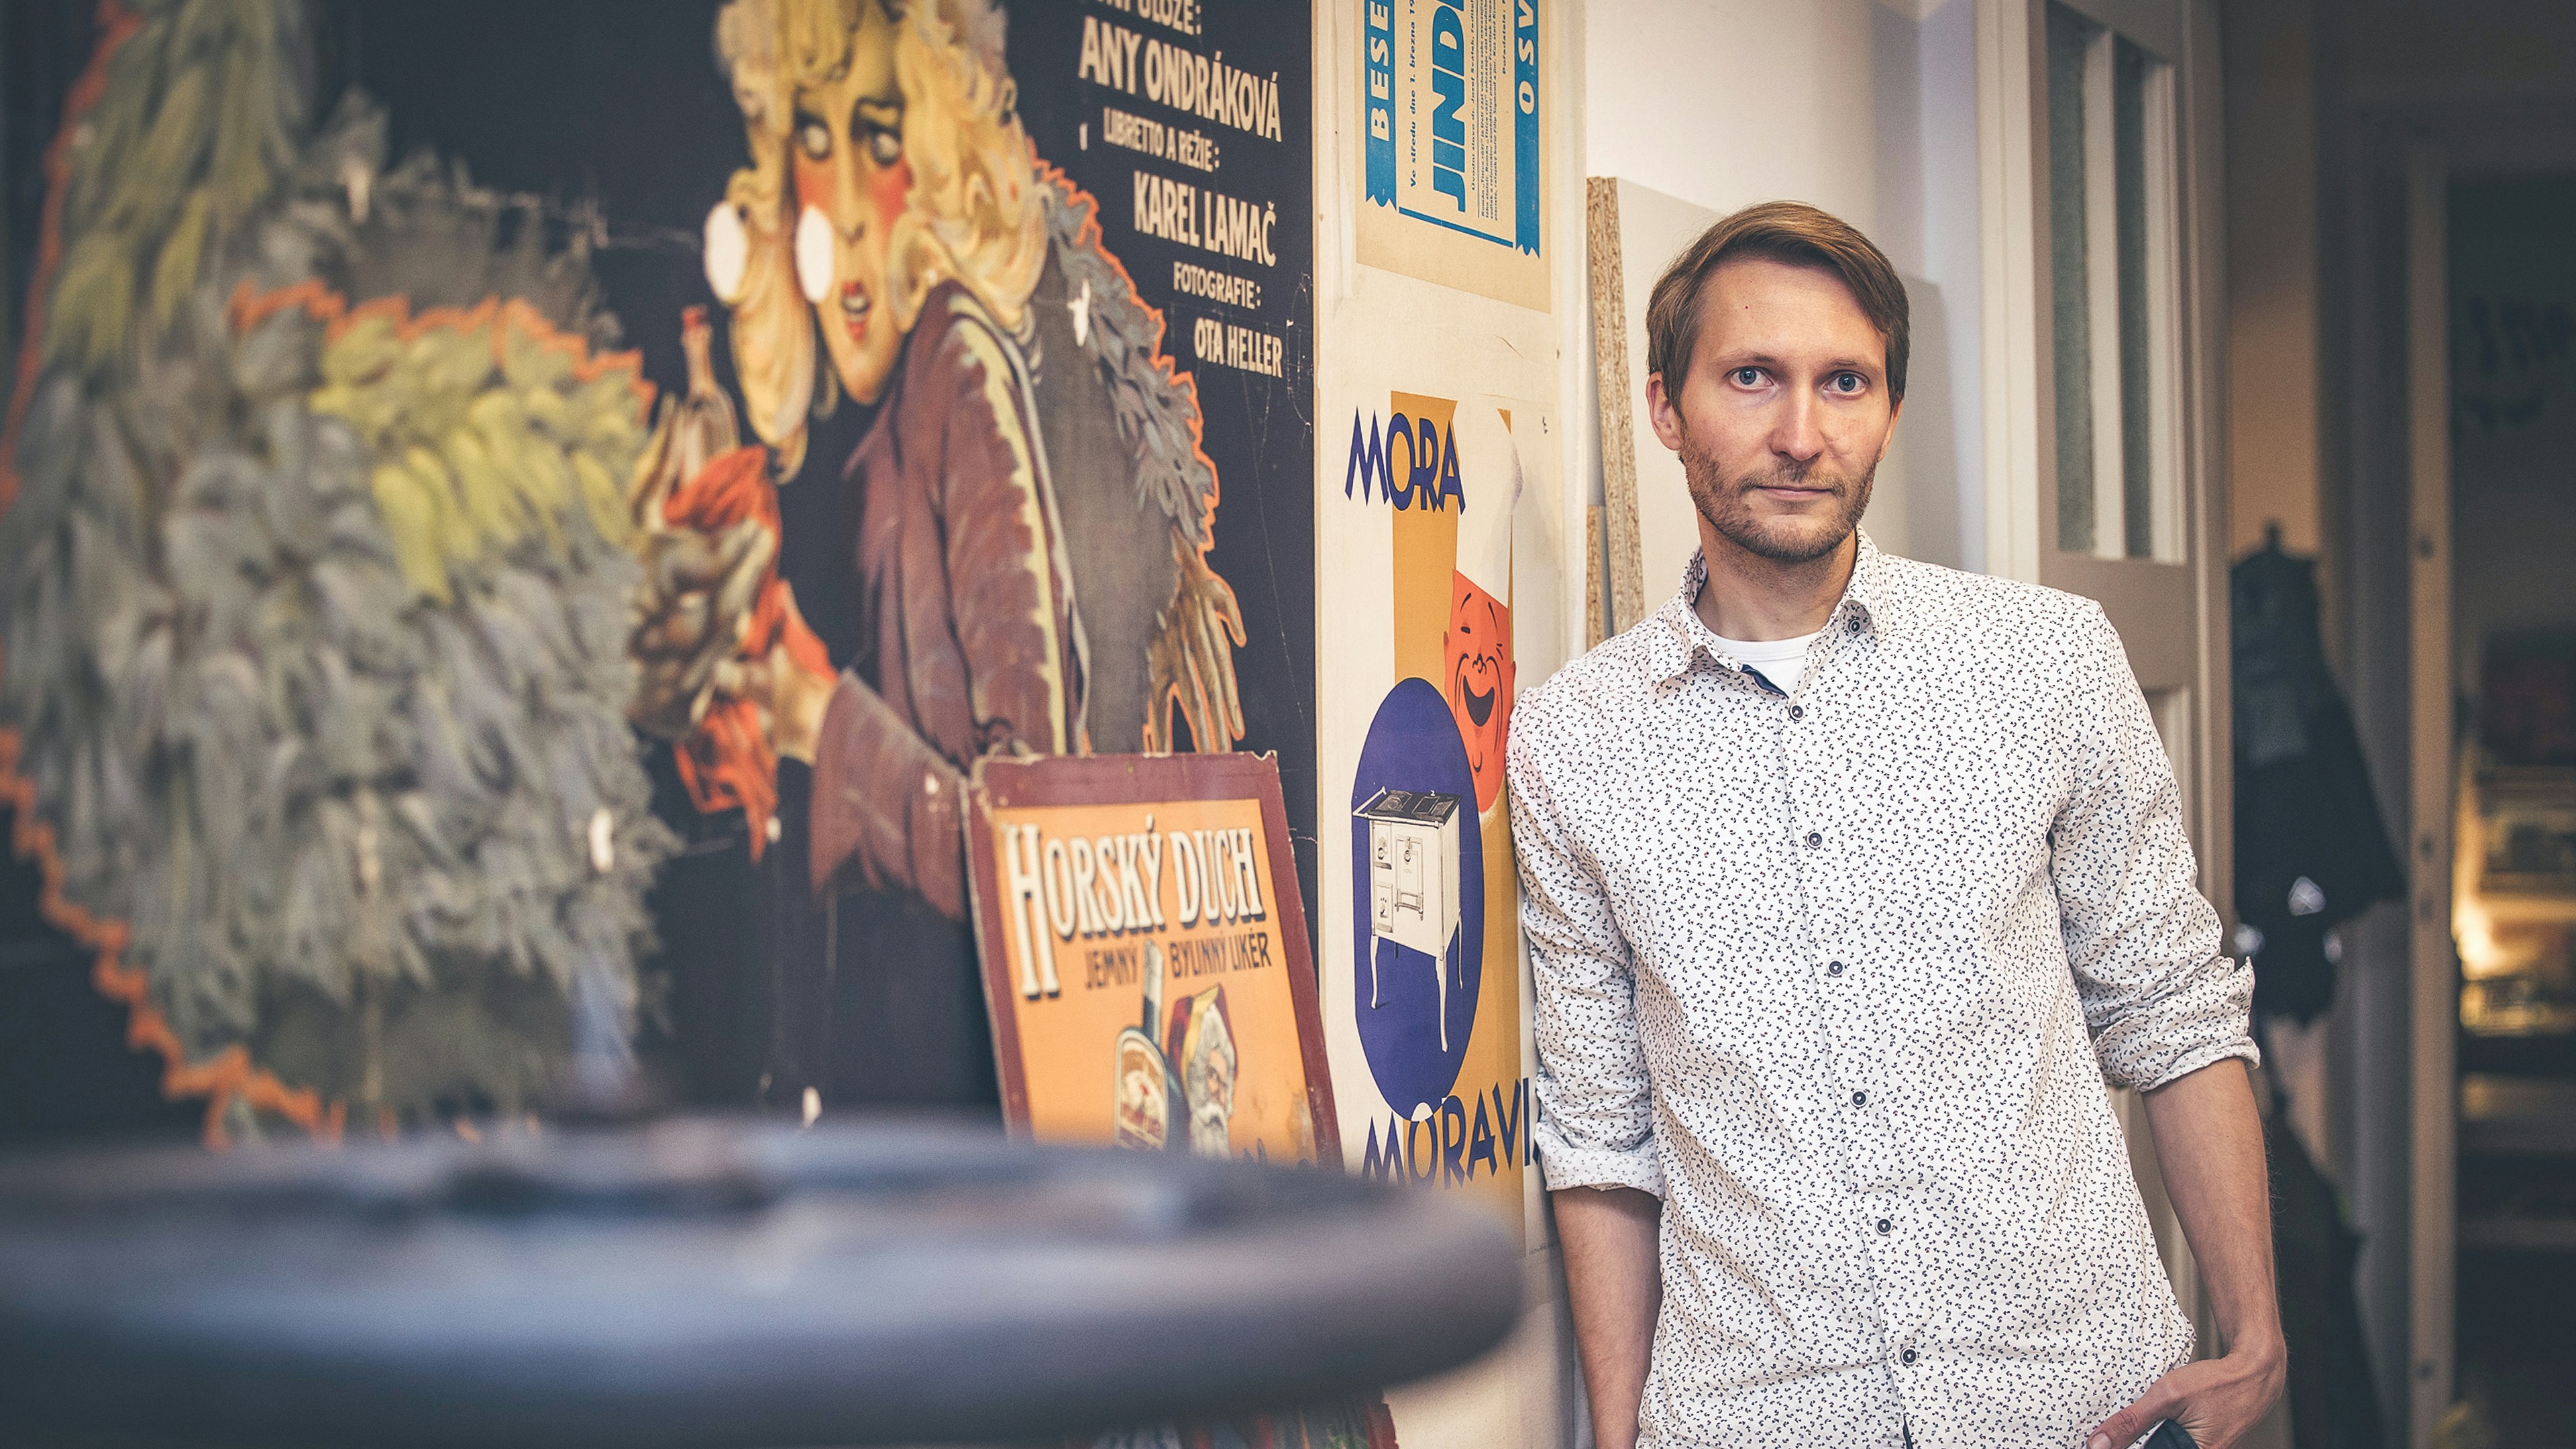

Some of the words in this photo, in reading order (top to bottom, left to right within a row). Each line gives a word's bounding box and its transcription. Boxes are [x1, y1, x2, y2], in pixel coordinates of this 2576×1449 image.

[1078, 15, 1142, 95] ANY
[1144, 38, 1282, 142] ONDRÁKOVÁ
[1370, 0, 1389, 142] BESE
[1409, 74, 1415, 83] 1.
[1104, 107, 1164, 158] LIBRETTO
[1166, 127, 1178, 161] A
[1179, 129, 1220, 172] REŽIE:
[1410, 170, 1416, 188] Ve
[1134, 170, 1200, 248] KAREL
[1203, 190, 1277, 267] LAMAČ
[1173, 261, 1261, 310] FOTOGRAFIE:
[1193, 317, 1224, 365] OTA
[1227, 324, 1283, 378] HELLER
[1344, 405, 1466, 515] MORA
[1004, 814, 1166, 1000] HORSKÝ
[1169, 826, 1267, 928] DUCH
[1084, 940, 1138, 989] JEMNÝ
[1169, 930, 1227, 979] BYLINNÝ
[1232, 927, 1273, 970] LIKÉR
[1361, 1077, 1541, 1191] MORAVI
